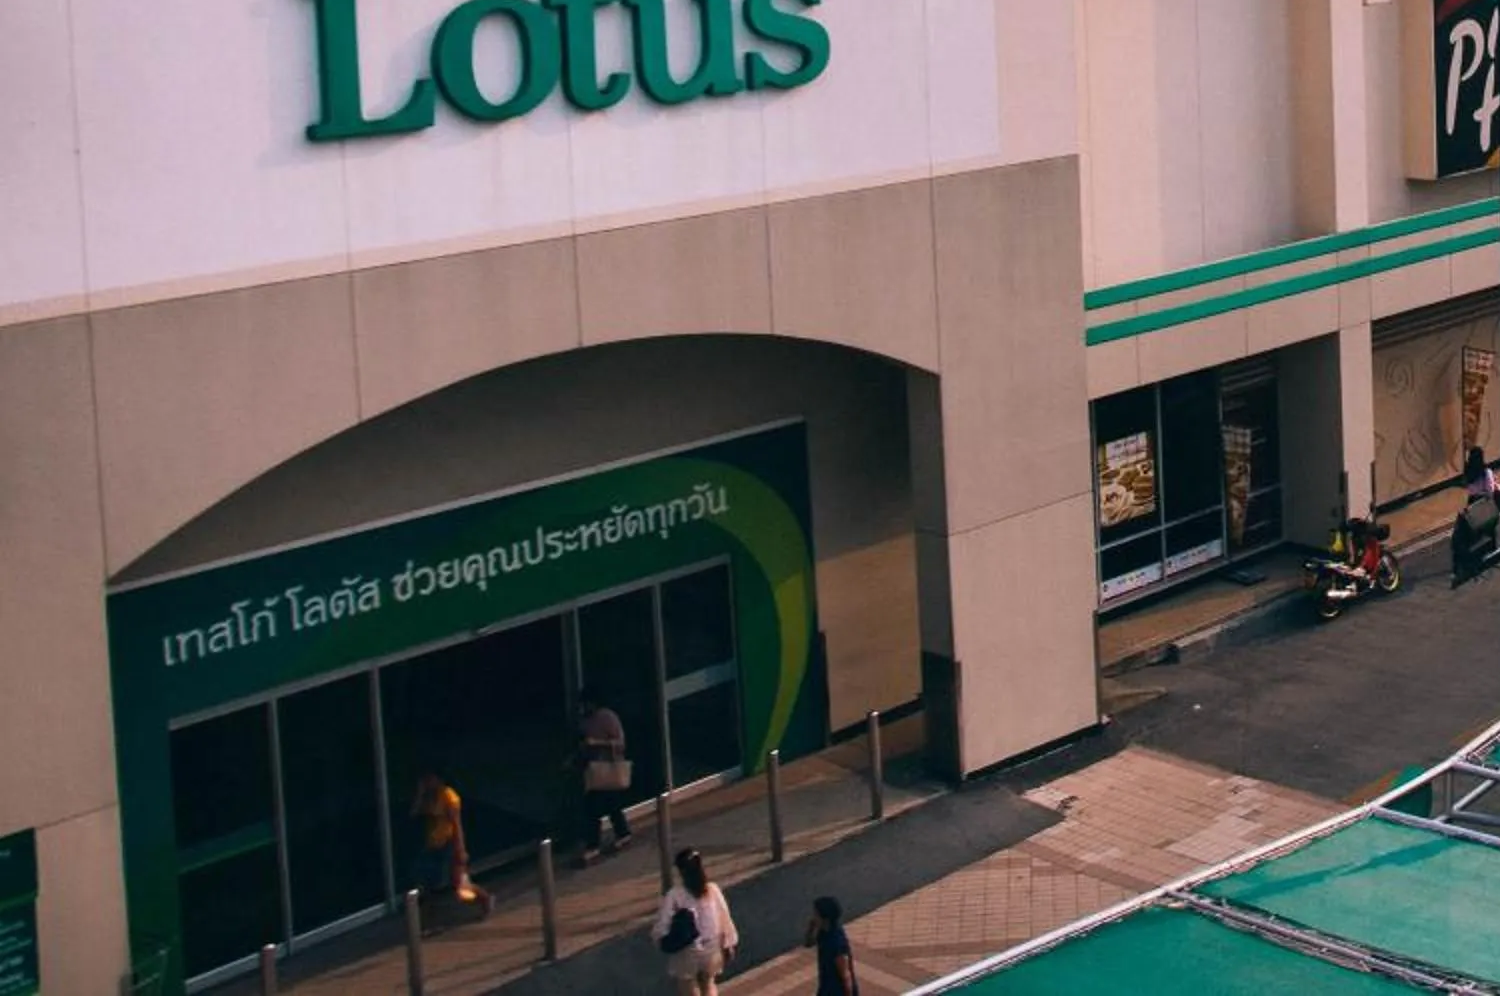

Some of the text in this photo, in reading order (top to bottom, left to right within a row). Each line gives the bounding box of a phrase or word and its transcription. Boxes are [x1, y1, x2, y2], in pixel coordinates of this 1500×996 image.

[163, 596, 281, 666] เทสโก้
[285, 574, 381, 631] โลตัส
